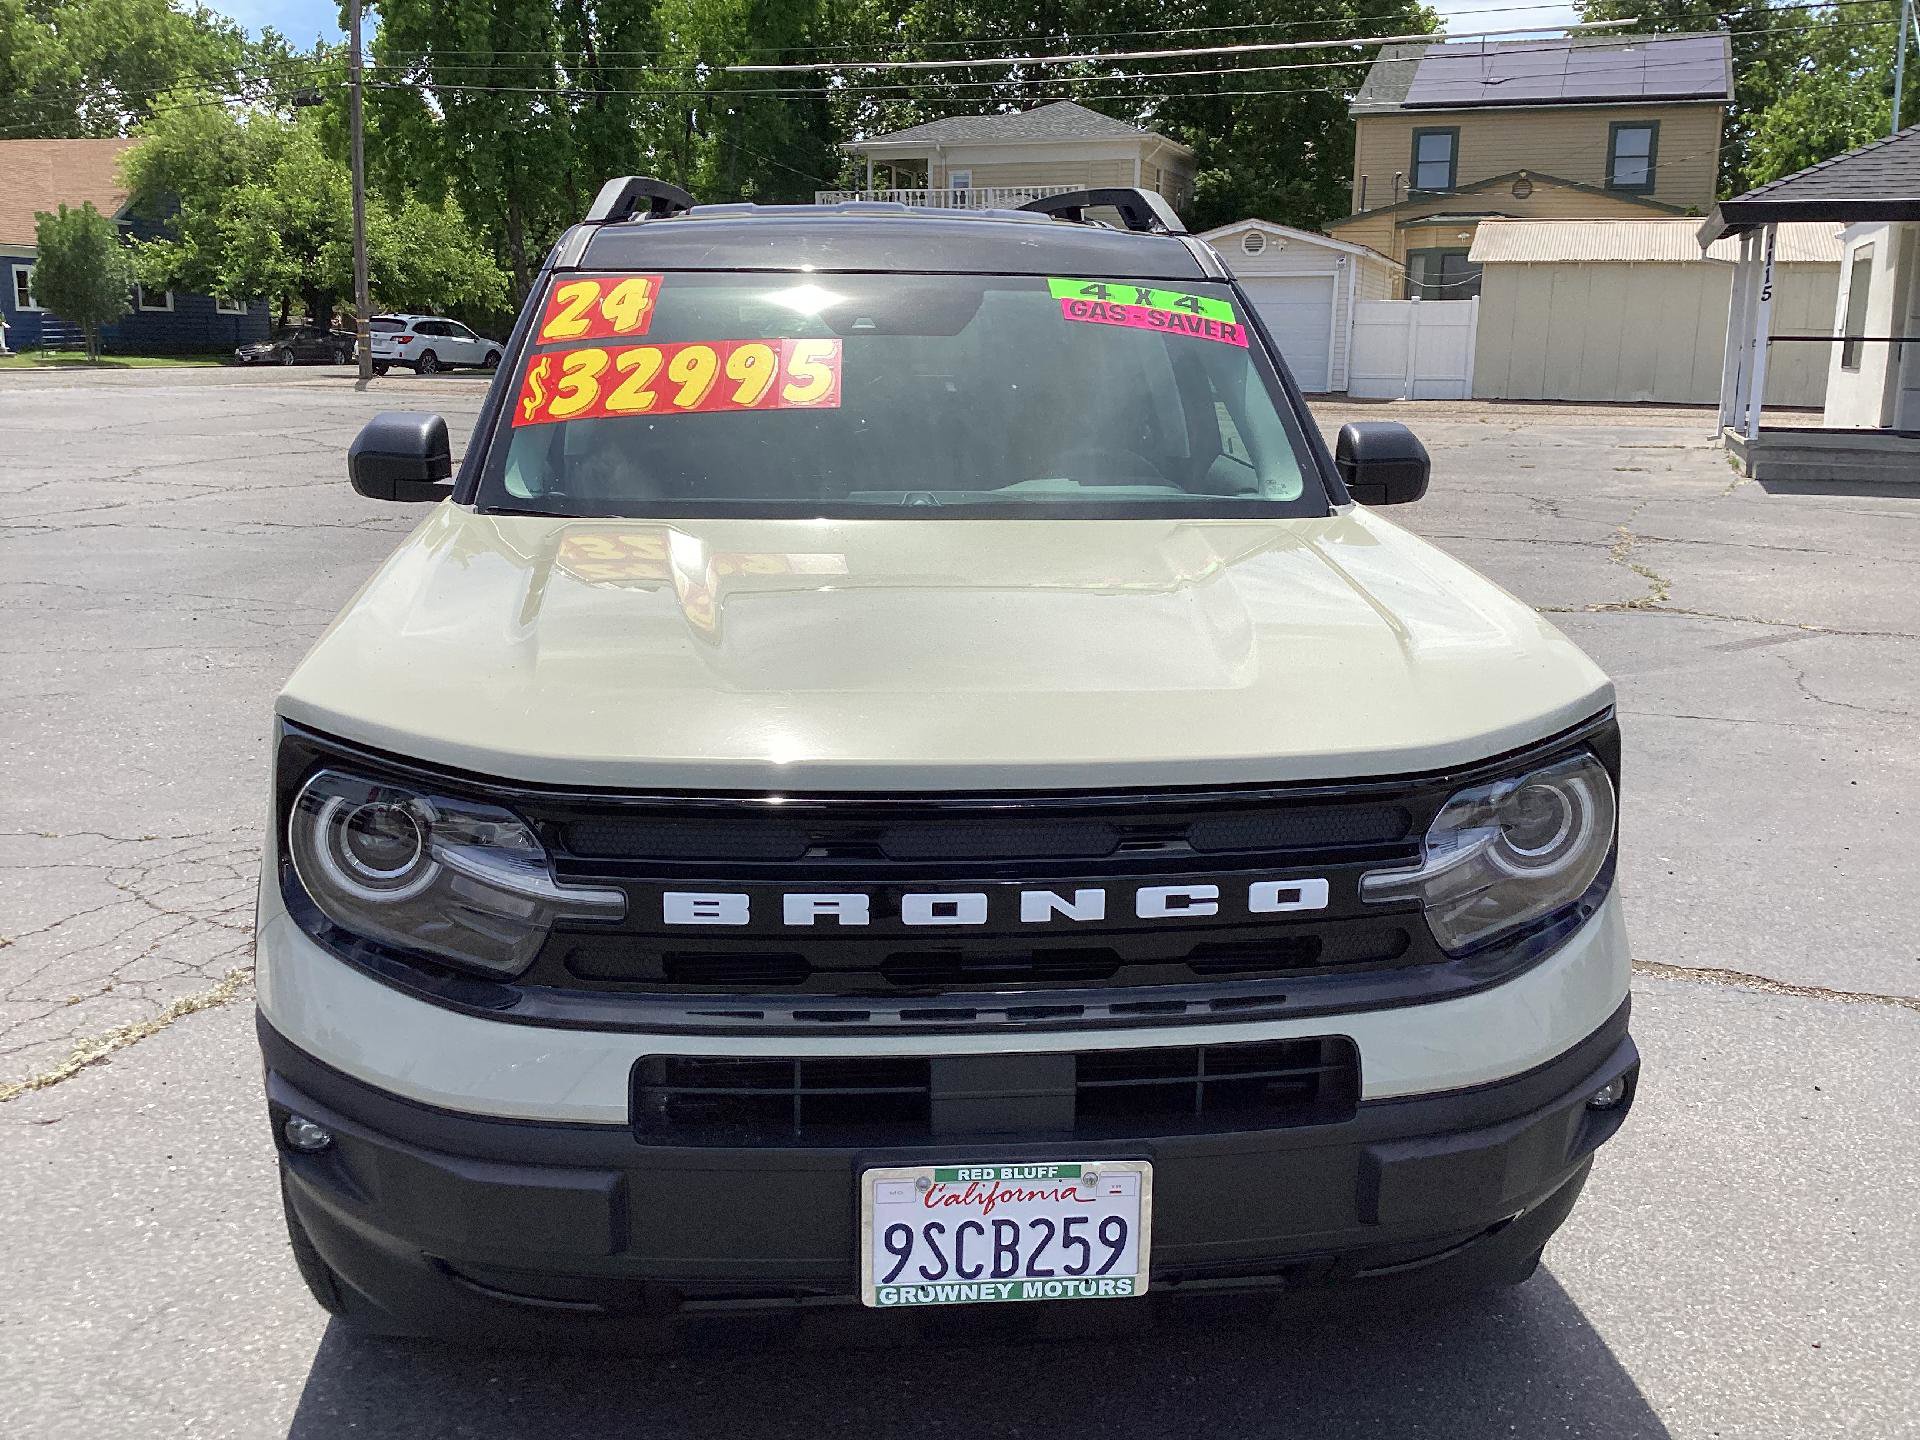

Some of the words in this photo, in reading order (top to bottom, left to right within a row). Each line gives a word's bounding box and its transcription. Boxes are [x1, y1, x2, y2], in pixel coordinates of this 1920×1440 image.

[1761, 233, 1774, 302] 1115
[543, 278, 652, 339] 24
[1080, 283, 1112, 300] 4
[1174, 295, 1206, 313] 4
[523, 340, 838, 420] $32995
[663, 878, 1329, 926] BRONCO
[957, 1168, 994, 1181] RED
[1002, 1166, 1059, 1180] BLUFF
[924, 1181, 1096, 1216] California
[883, 1215, 1128, 1284] 9SCB259
[879, 1282, 1013, 1304] GROWNEY
[1022, 1277, 1133, 1299] MOTORS
